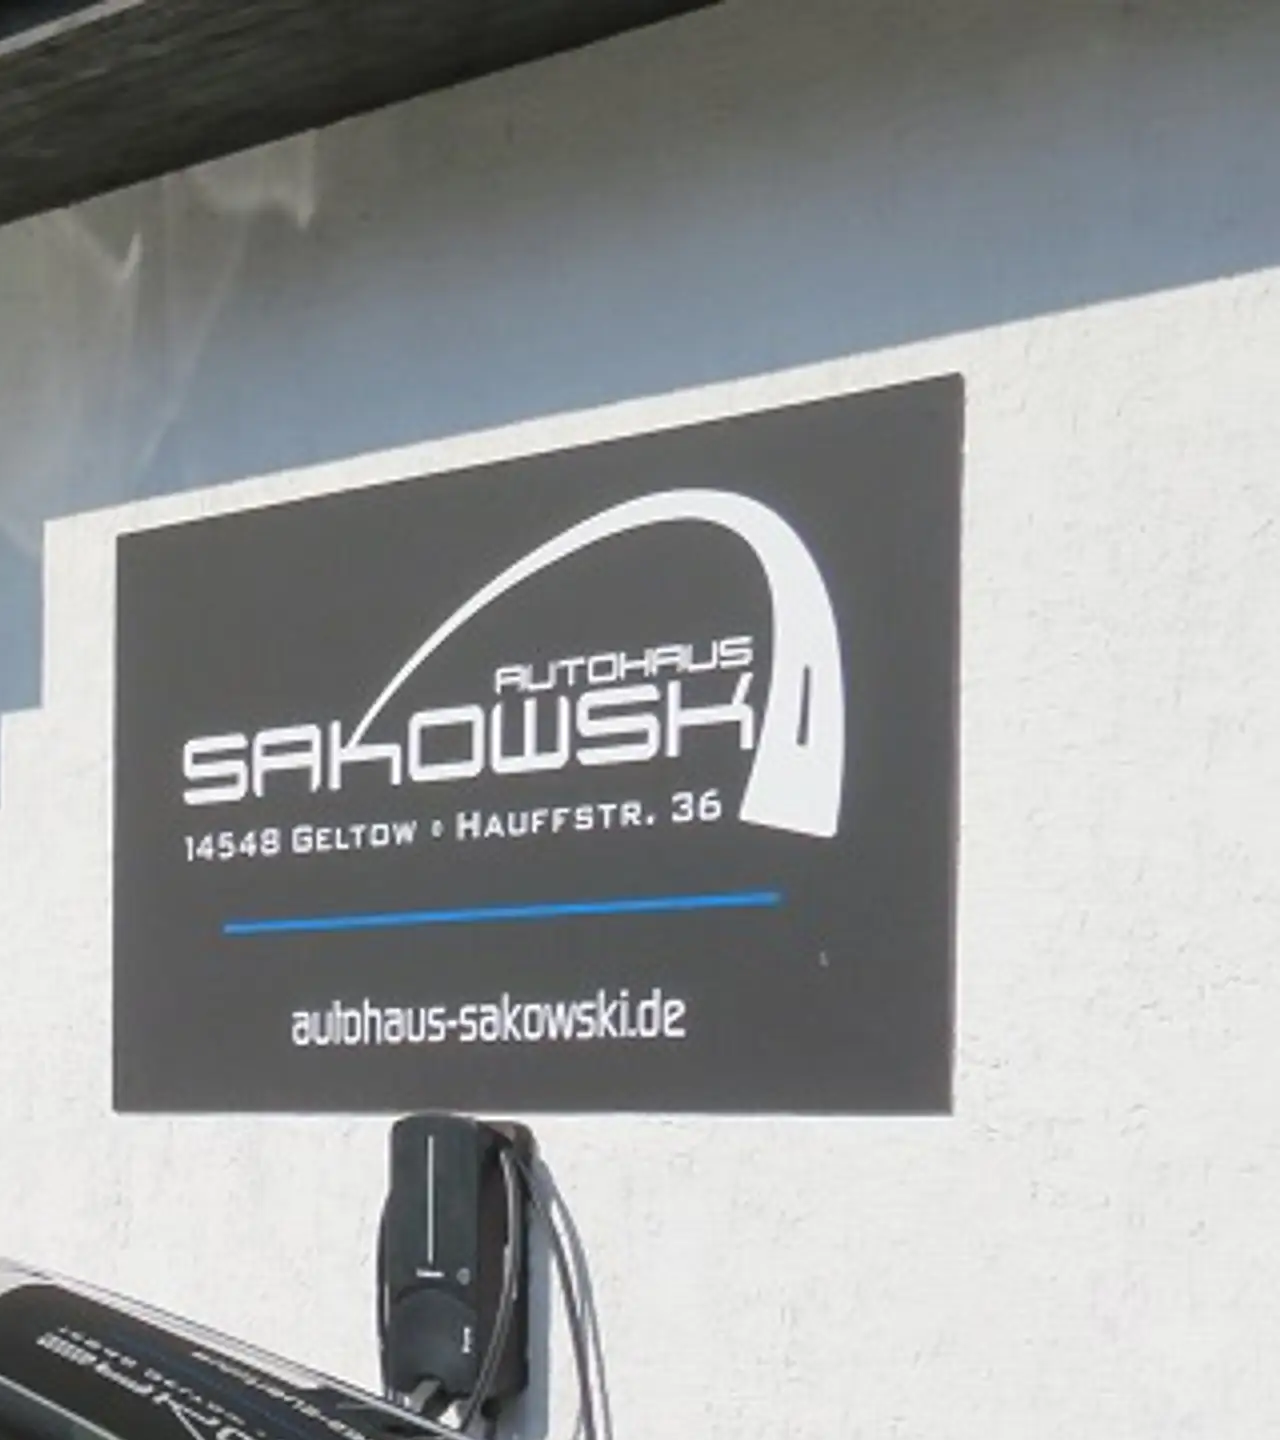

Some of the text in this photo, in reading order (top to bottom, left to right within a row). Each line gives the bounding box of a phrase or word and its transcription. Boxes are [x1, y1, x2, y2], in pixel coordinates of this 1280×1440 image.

[494, 635, 755, 695] AUTOHAUS
[184, 787, 723, 864] 14548 GELTOW HAUFFSTR. 36
[291, 987, 688, 1047] autohaus-sakowski.de
